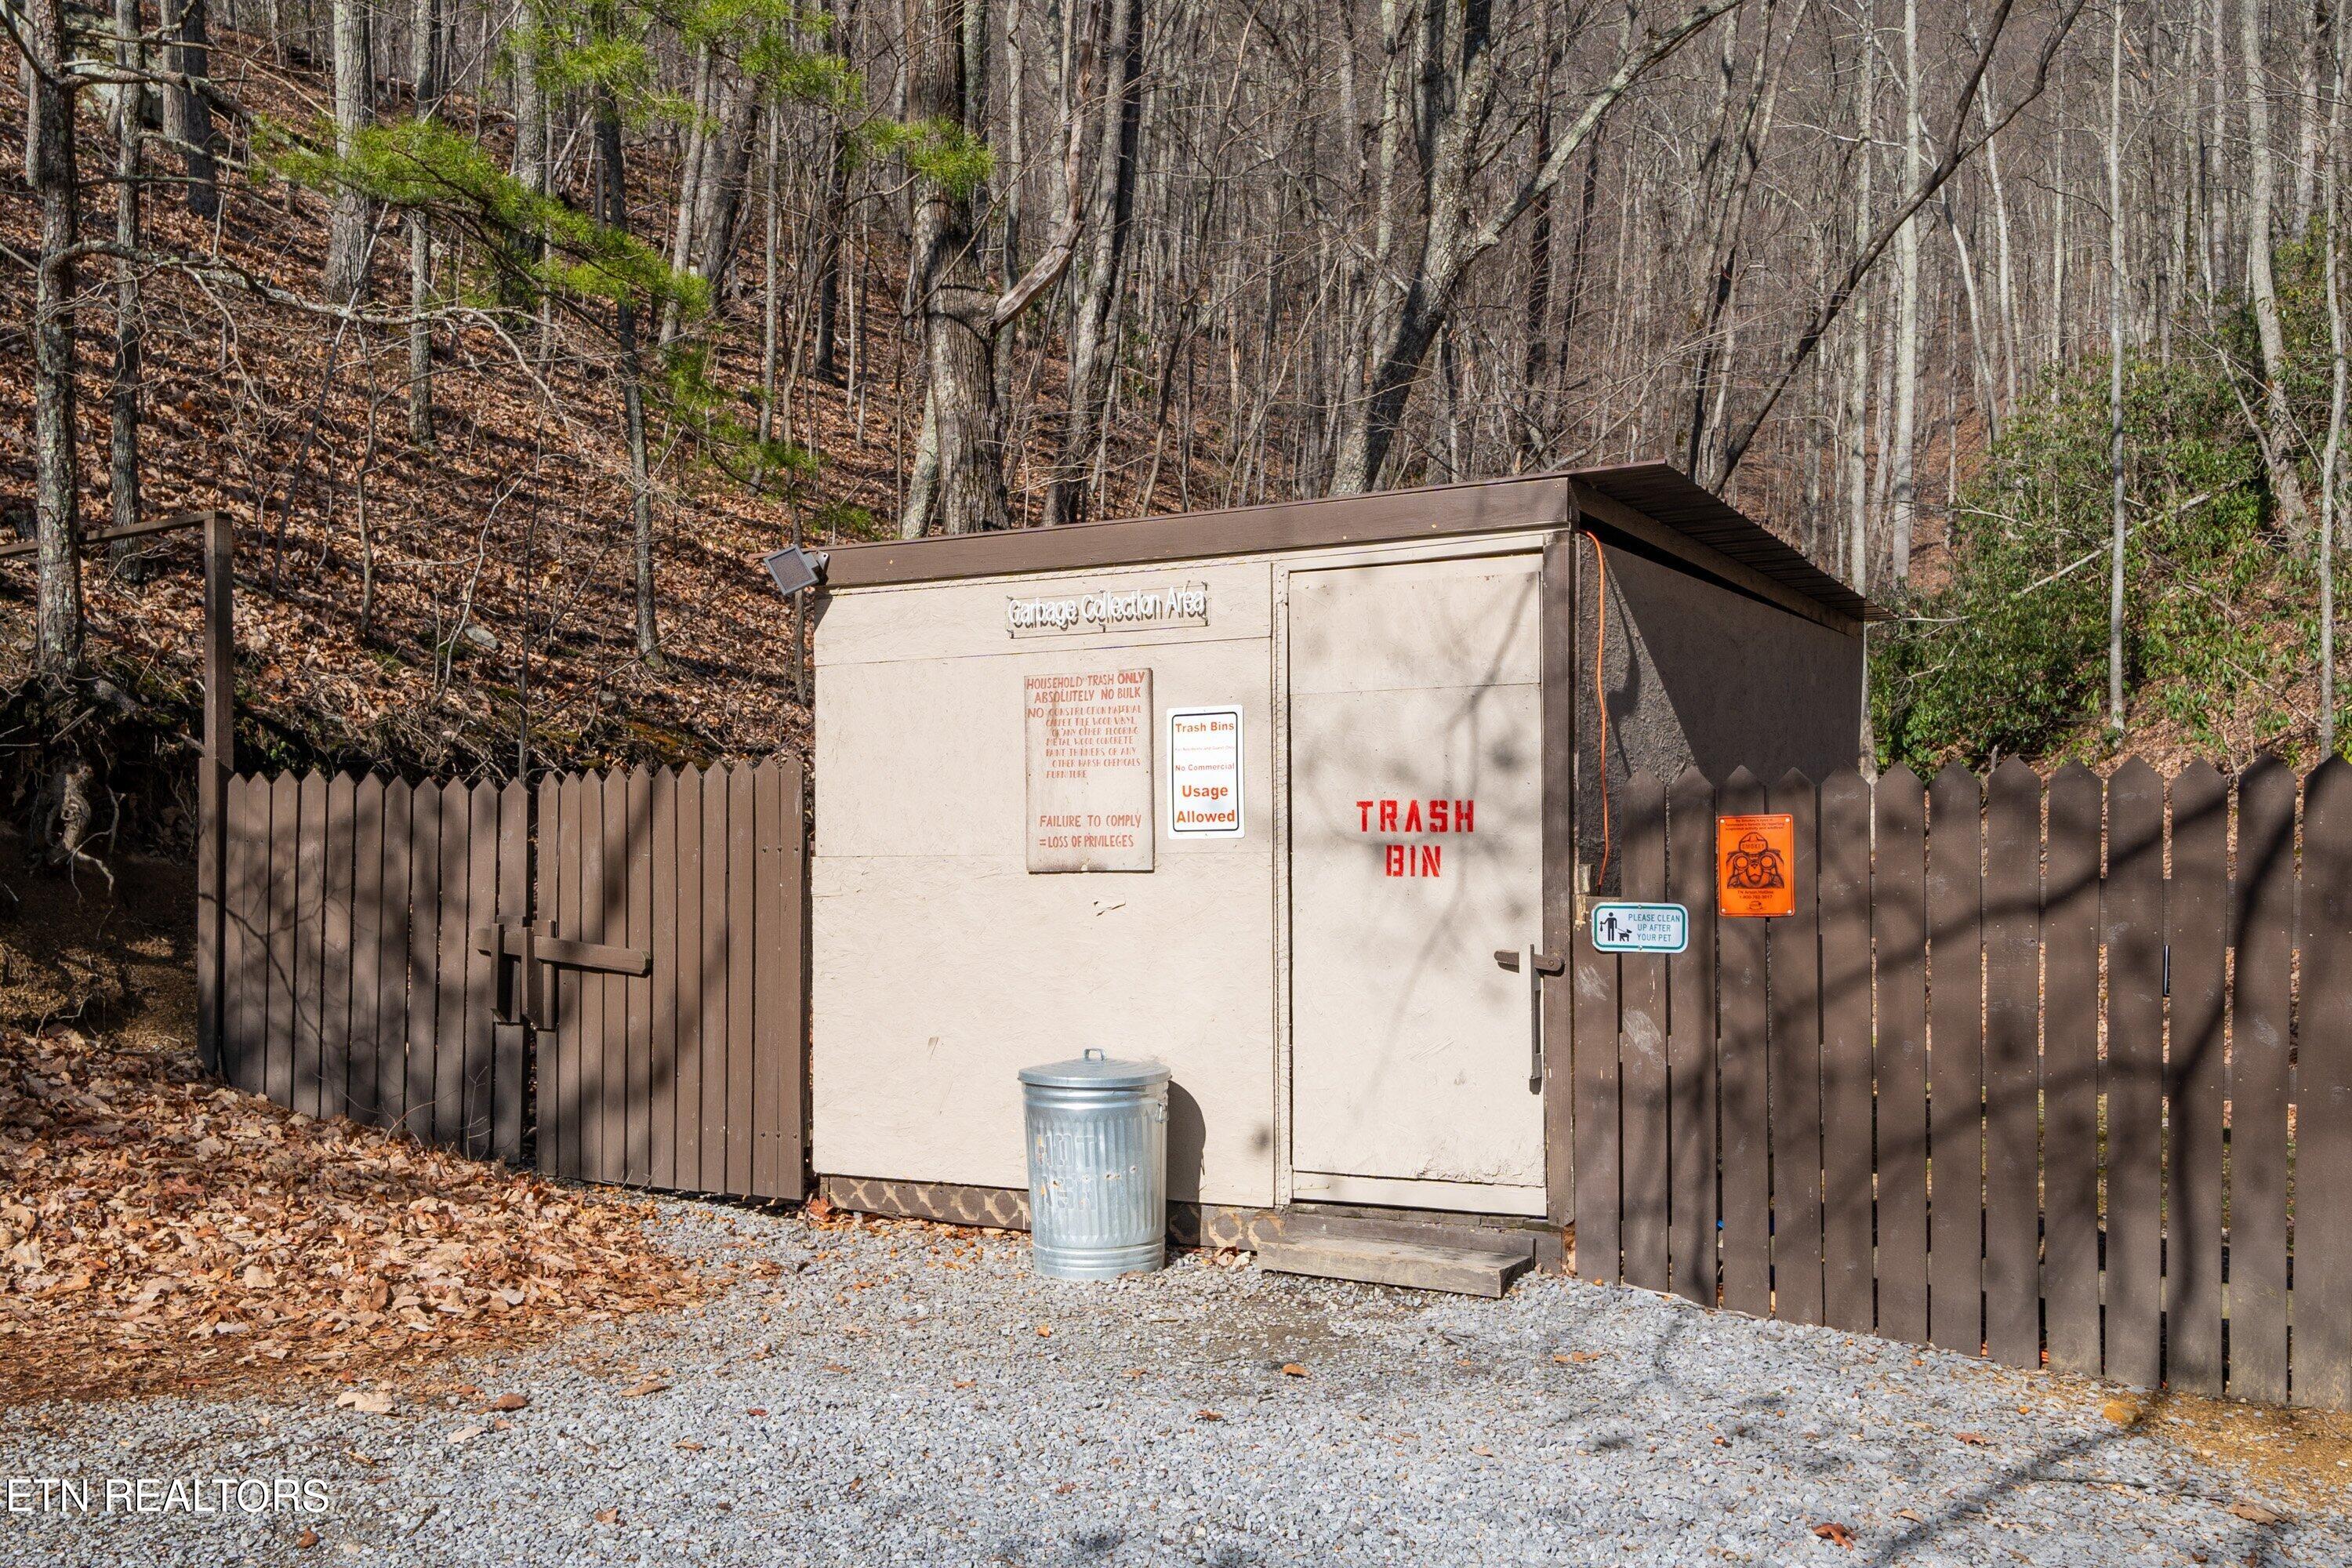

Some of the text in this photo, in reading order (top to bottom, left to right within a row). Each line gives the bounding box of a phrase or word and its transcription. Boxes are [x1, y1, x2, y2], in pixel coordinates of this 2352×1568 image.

[1008, 586, 1206, 626] Garbage Collection Area
[1027, 671, 1145, 690] HOUSEHOLD TRASH ONLY
[1034, 686, 1142, 704] ABSOLUTELY NO BULK
[1028, 707, 1044, 718] NO
[1175, 721, 1235, 732] Trash Bins
[1182, 785, 1229, 800] Usage
[1040, 814, 1142, 828] FAILURE TO COMPLY
[1177, 809, 1236, 822] Allowed
[1356, 800, 1474, 832] TRASH
[1072, 835, 1083, 848] OF
[1084, 835, 1134, 848] PRIVILEGES
[1386, 844, 1441, 877] BIN
[1628, 913, 1655, 922] PLEASE
